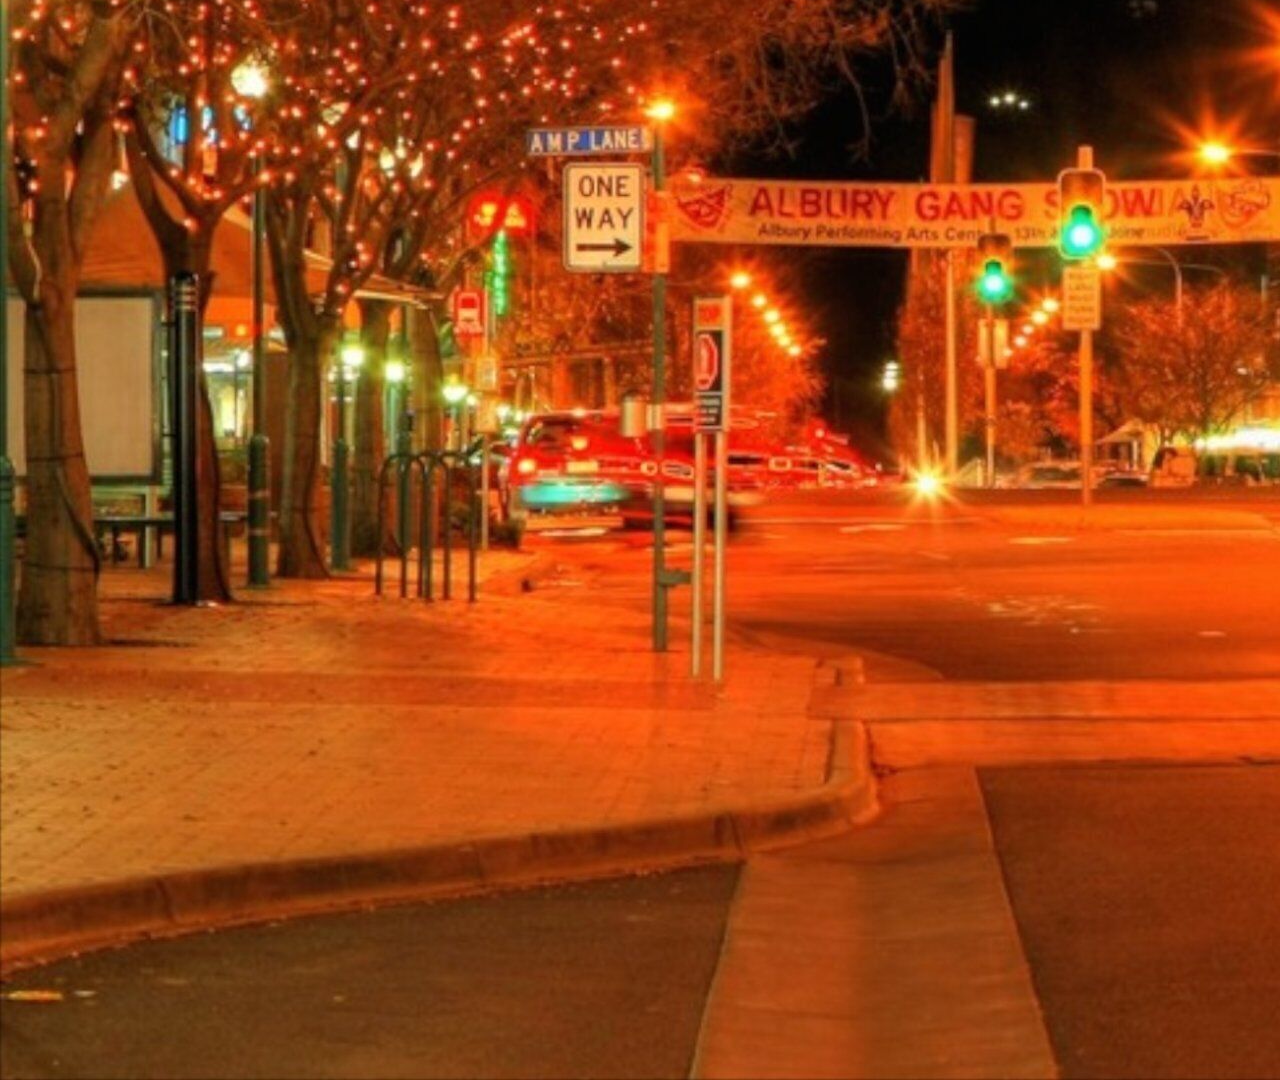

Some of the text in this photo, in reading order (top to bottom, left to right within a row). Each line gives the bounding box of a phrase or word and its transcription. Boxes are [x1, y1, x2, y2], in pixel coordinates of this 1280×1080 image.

[590, 128, 640, 151] LANE
[578, 175, 631, 197] ONE
[751, 187, 896, 219] ALBURY
[914, 190, 1025, 221] GANG
[574, 207, 633, 229] WAY
[758, 223, 811, 240] Albury
[816, 224, 900, 241] Performing
[907, 226, 939, 240] Arts
